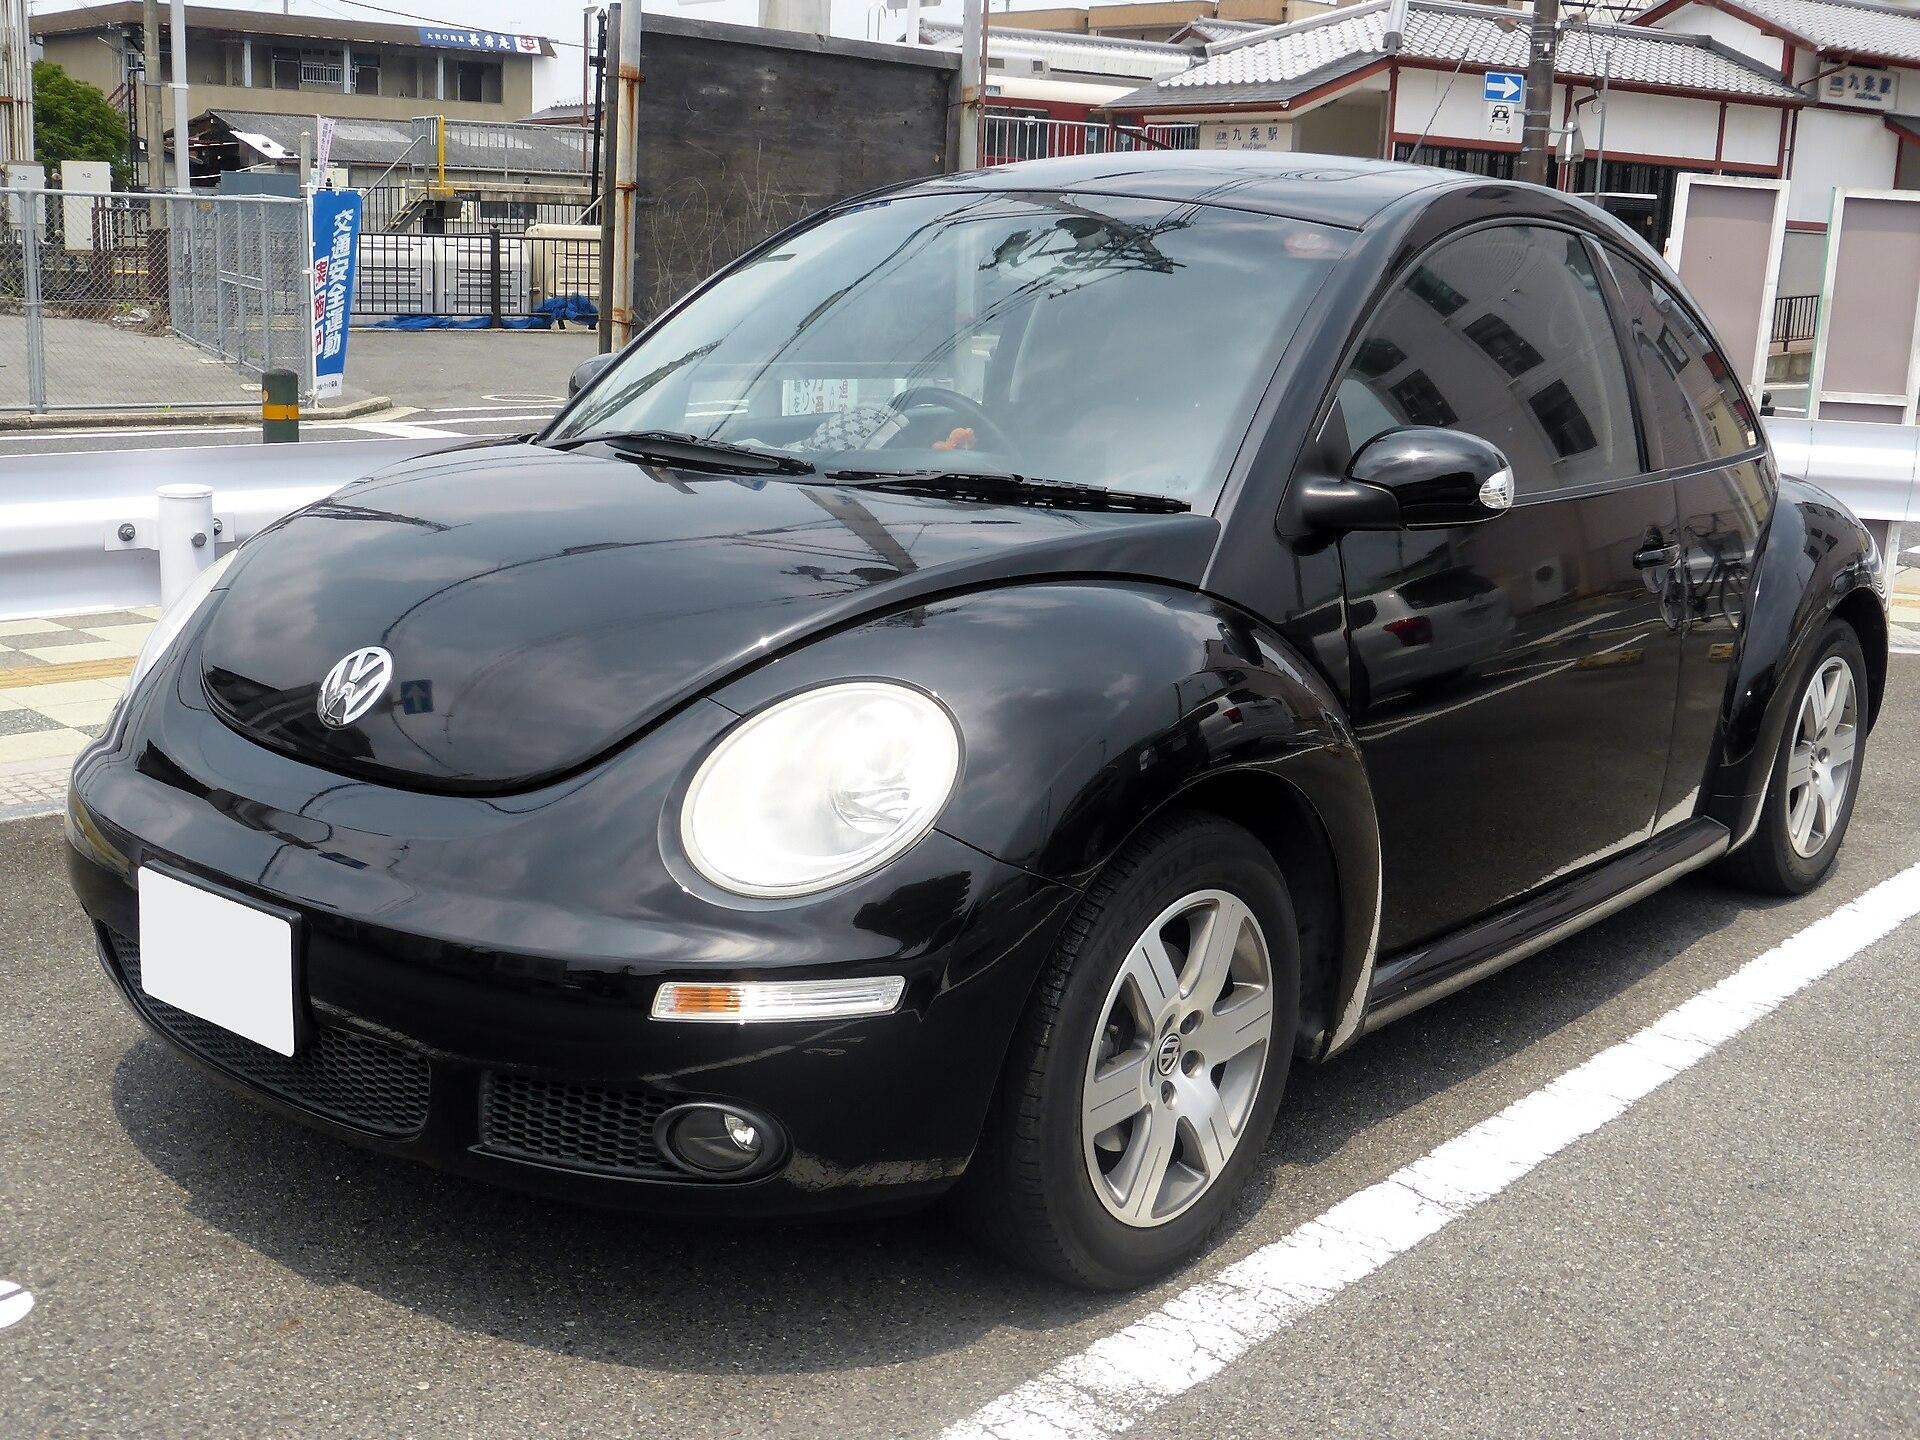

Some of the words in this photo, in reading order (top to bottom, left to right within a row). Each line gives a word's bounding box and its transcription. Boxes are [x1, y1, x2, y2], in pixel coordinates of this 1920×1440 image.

[1232, 126, 1278, 141] 九条駅
[314, 260, 328, 352] 実施中
[323, 208, 354, 360] 交通安全運動
[317, 646, 393, 730] VW
